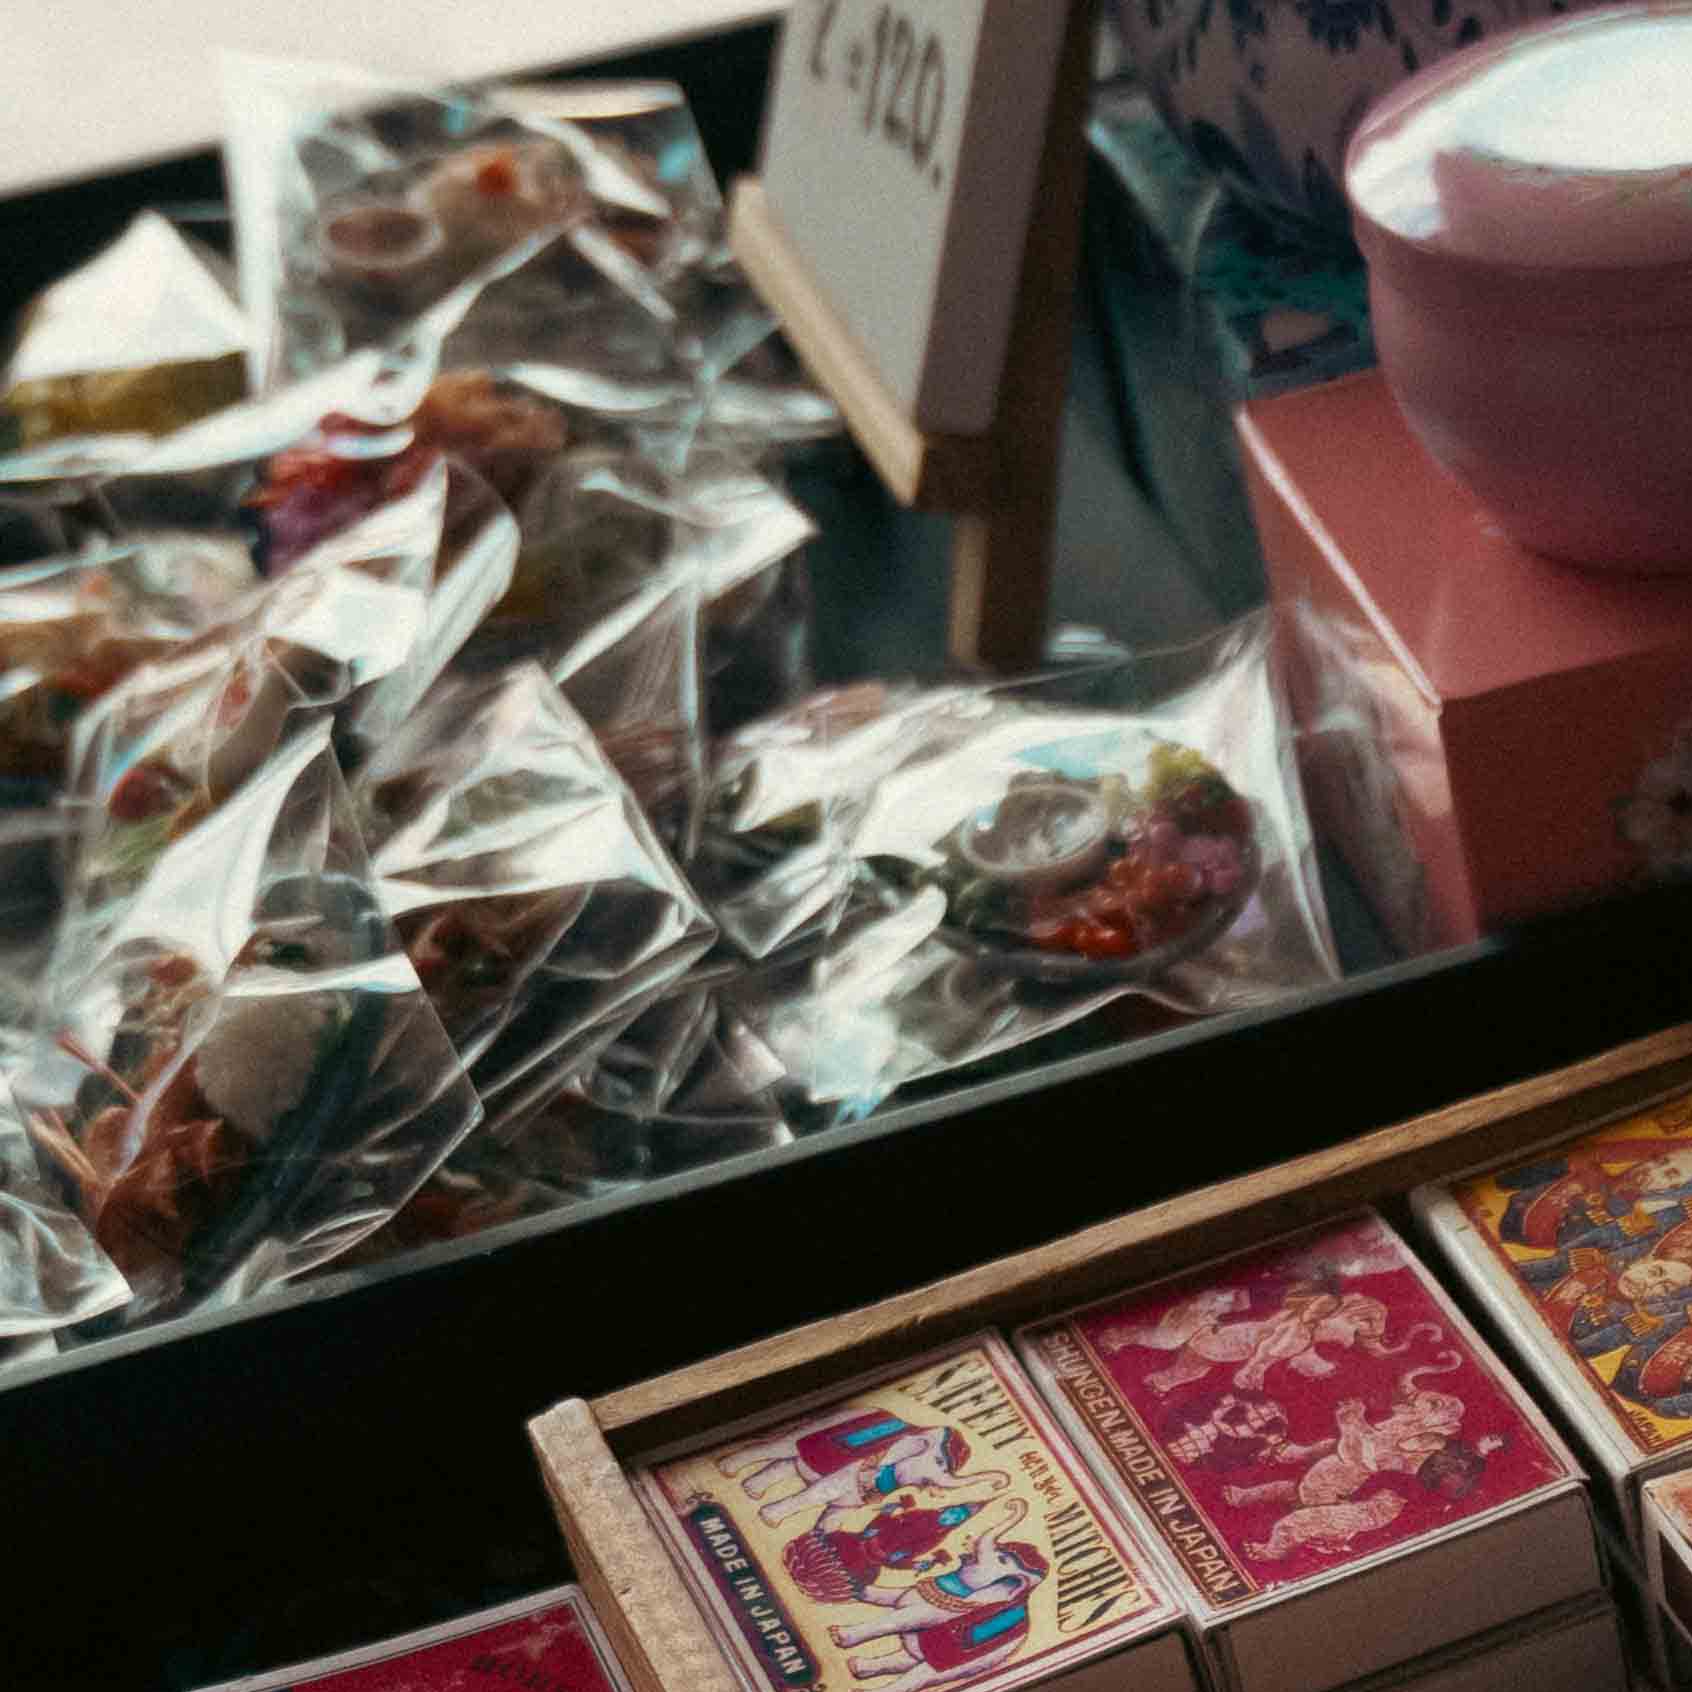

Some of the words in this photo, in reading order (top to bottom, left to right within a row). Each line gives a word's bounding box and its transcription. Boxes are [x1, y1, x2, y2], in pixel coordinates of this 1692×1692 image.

[916, 1360, 1029, 1452] SAFETY
[1043, 1503, 1144, 1634] MATCHES
[1151, 1488, 1176, 1516] IN
[1168, 1511, 1240, 1594] JAPAN
[697, 1514, 741, 1574] MADE
[733, 1570, 754, 1600] IN
[748, 1601, 808, 1679] JAPAN
